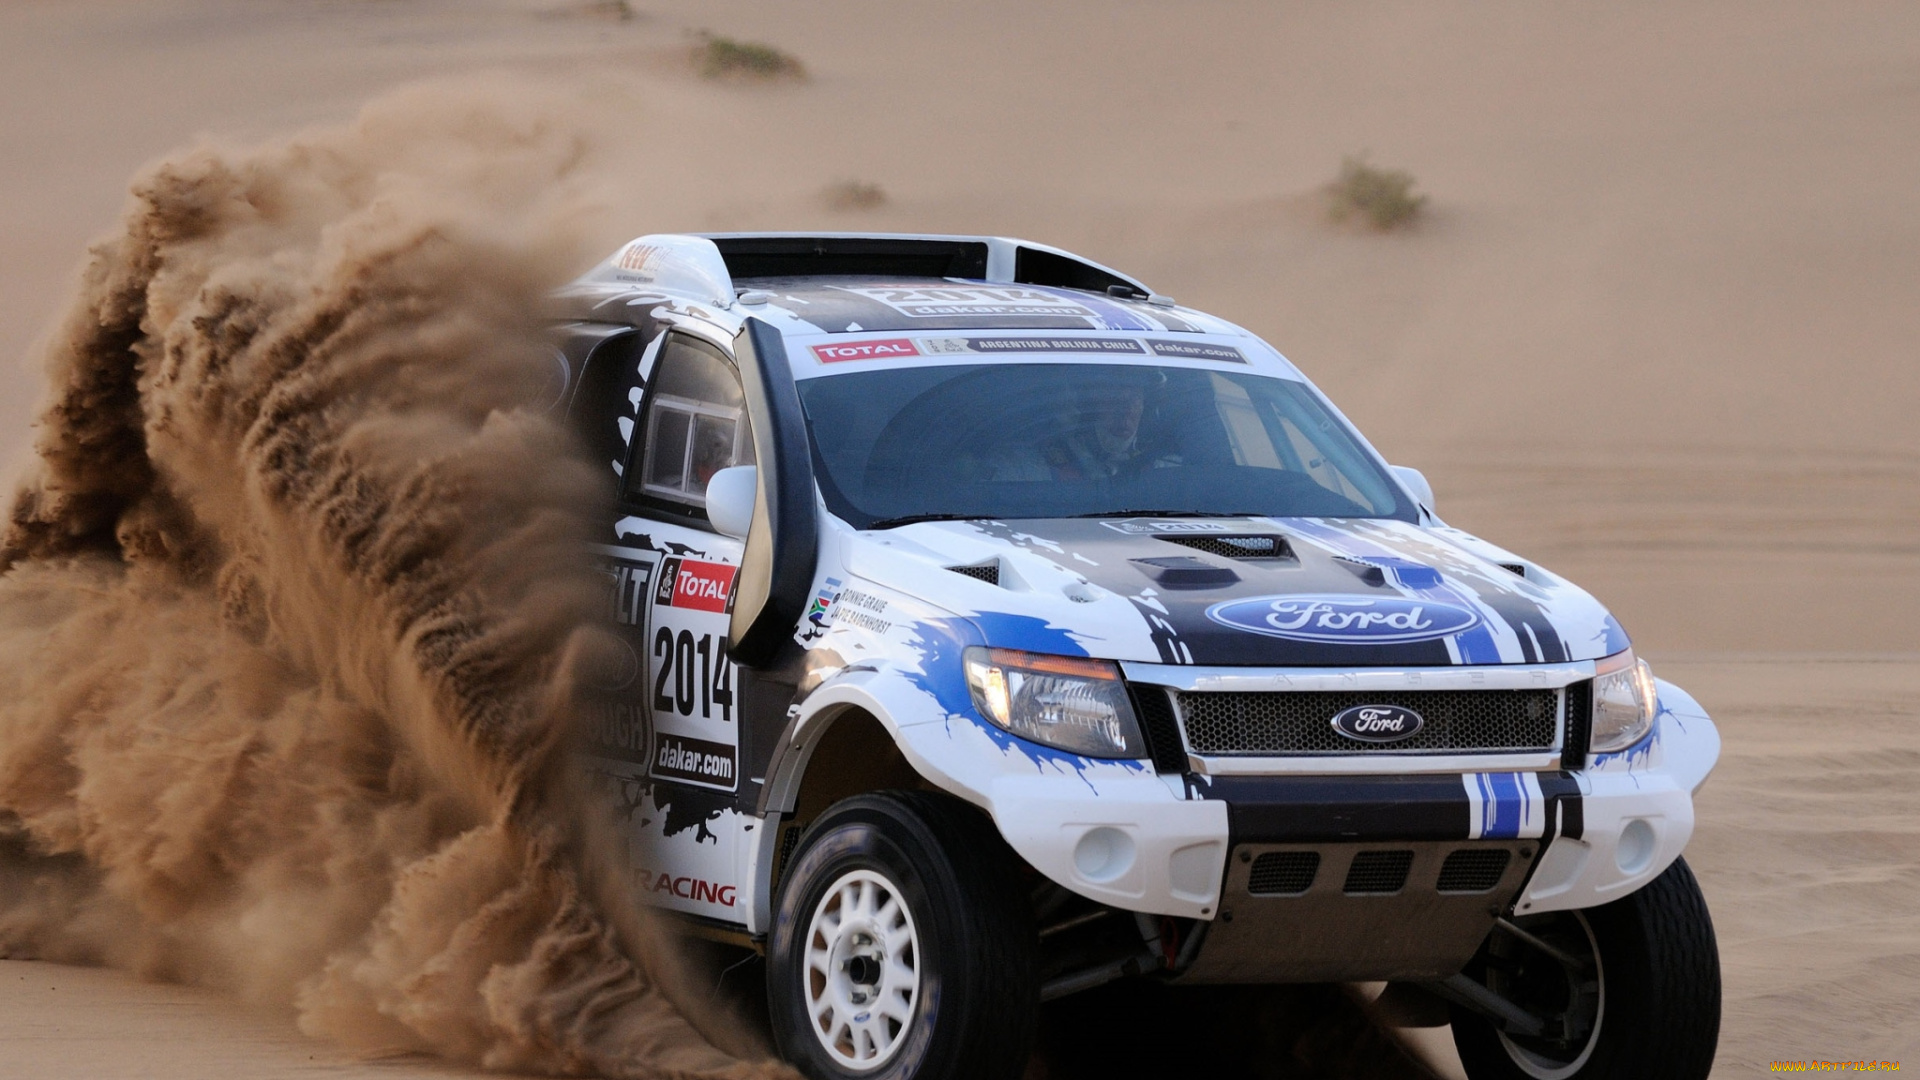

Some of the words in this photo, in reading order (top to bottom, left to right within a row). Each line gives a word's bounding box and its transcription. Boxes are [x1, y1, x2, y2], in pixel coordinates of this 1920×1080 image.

[868, 288, 1060, 302] 2014
[914, 304, 1082, 315] dakar.com
[979, 340, 1050, 349] ARGENTINA
[1051, 340, 1101, 349] BOLIVIA
[1103, 340, 1138, 351] CHILE
[1154, 343, 1239, 358] dakar.com
[841, 588, 867, 606] RONNIE
[1266, 600, 1432, 629] Ford
[654, 626, 733, 721] 2014
[1355, 709, 1404, 732] Ford
[658, 740, 732, 778] dakar.com
[633, 868, 736, 907] RACING
